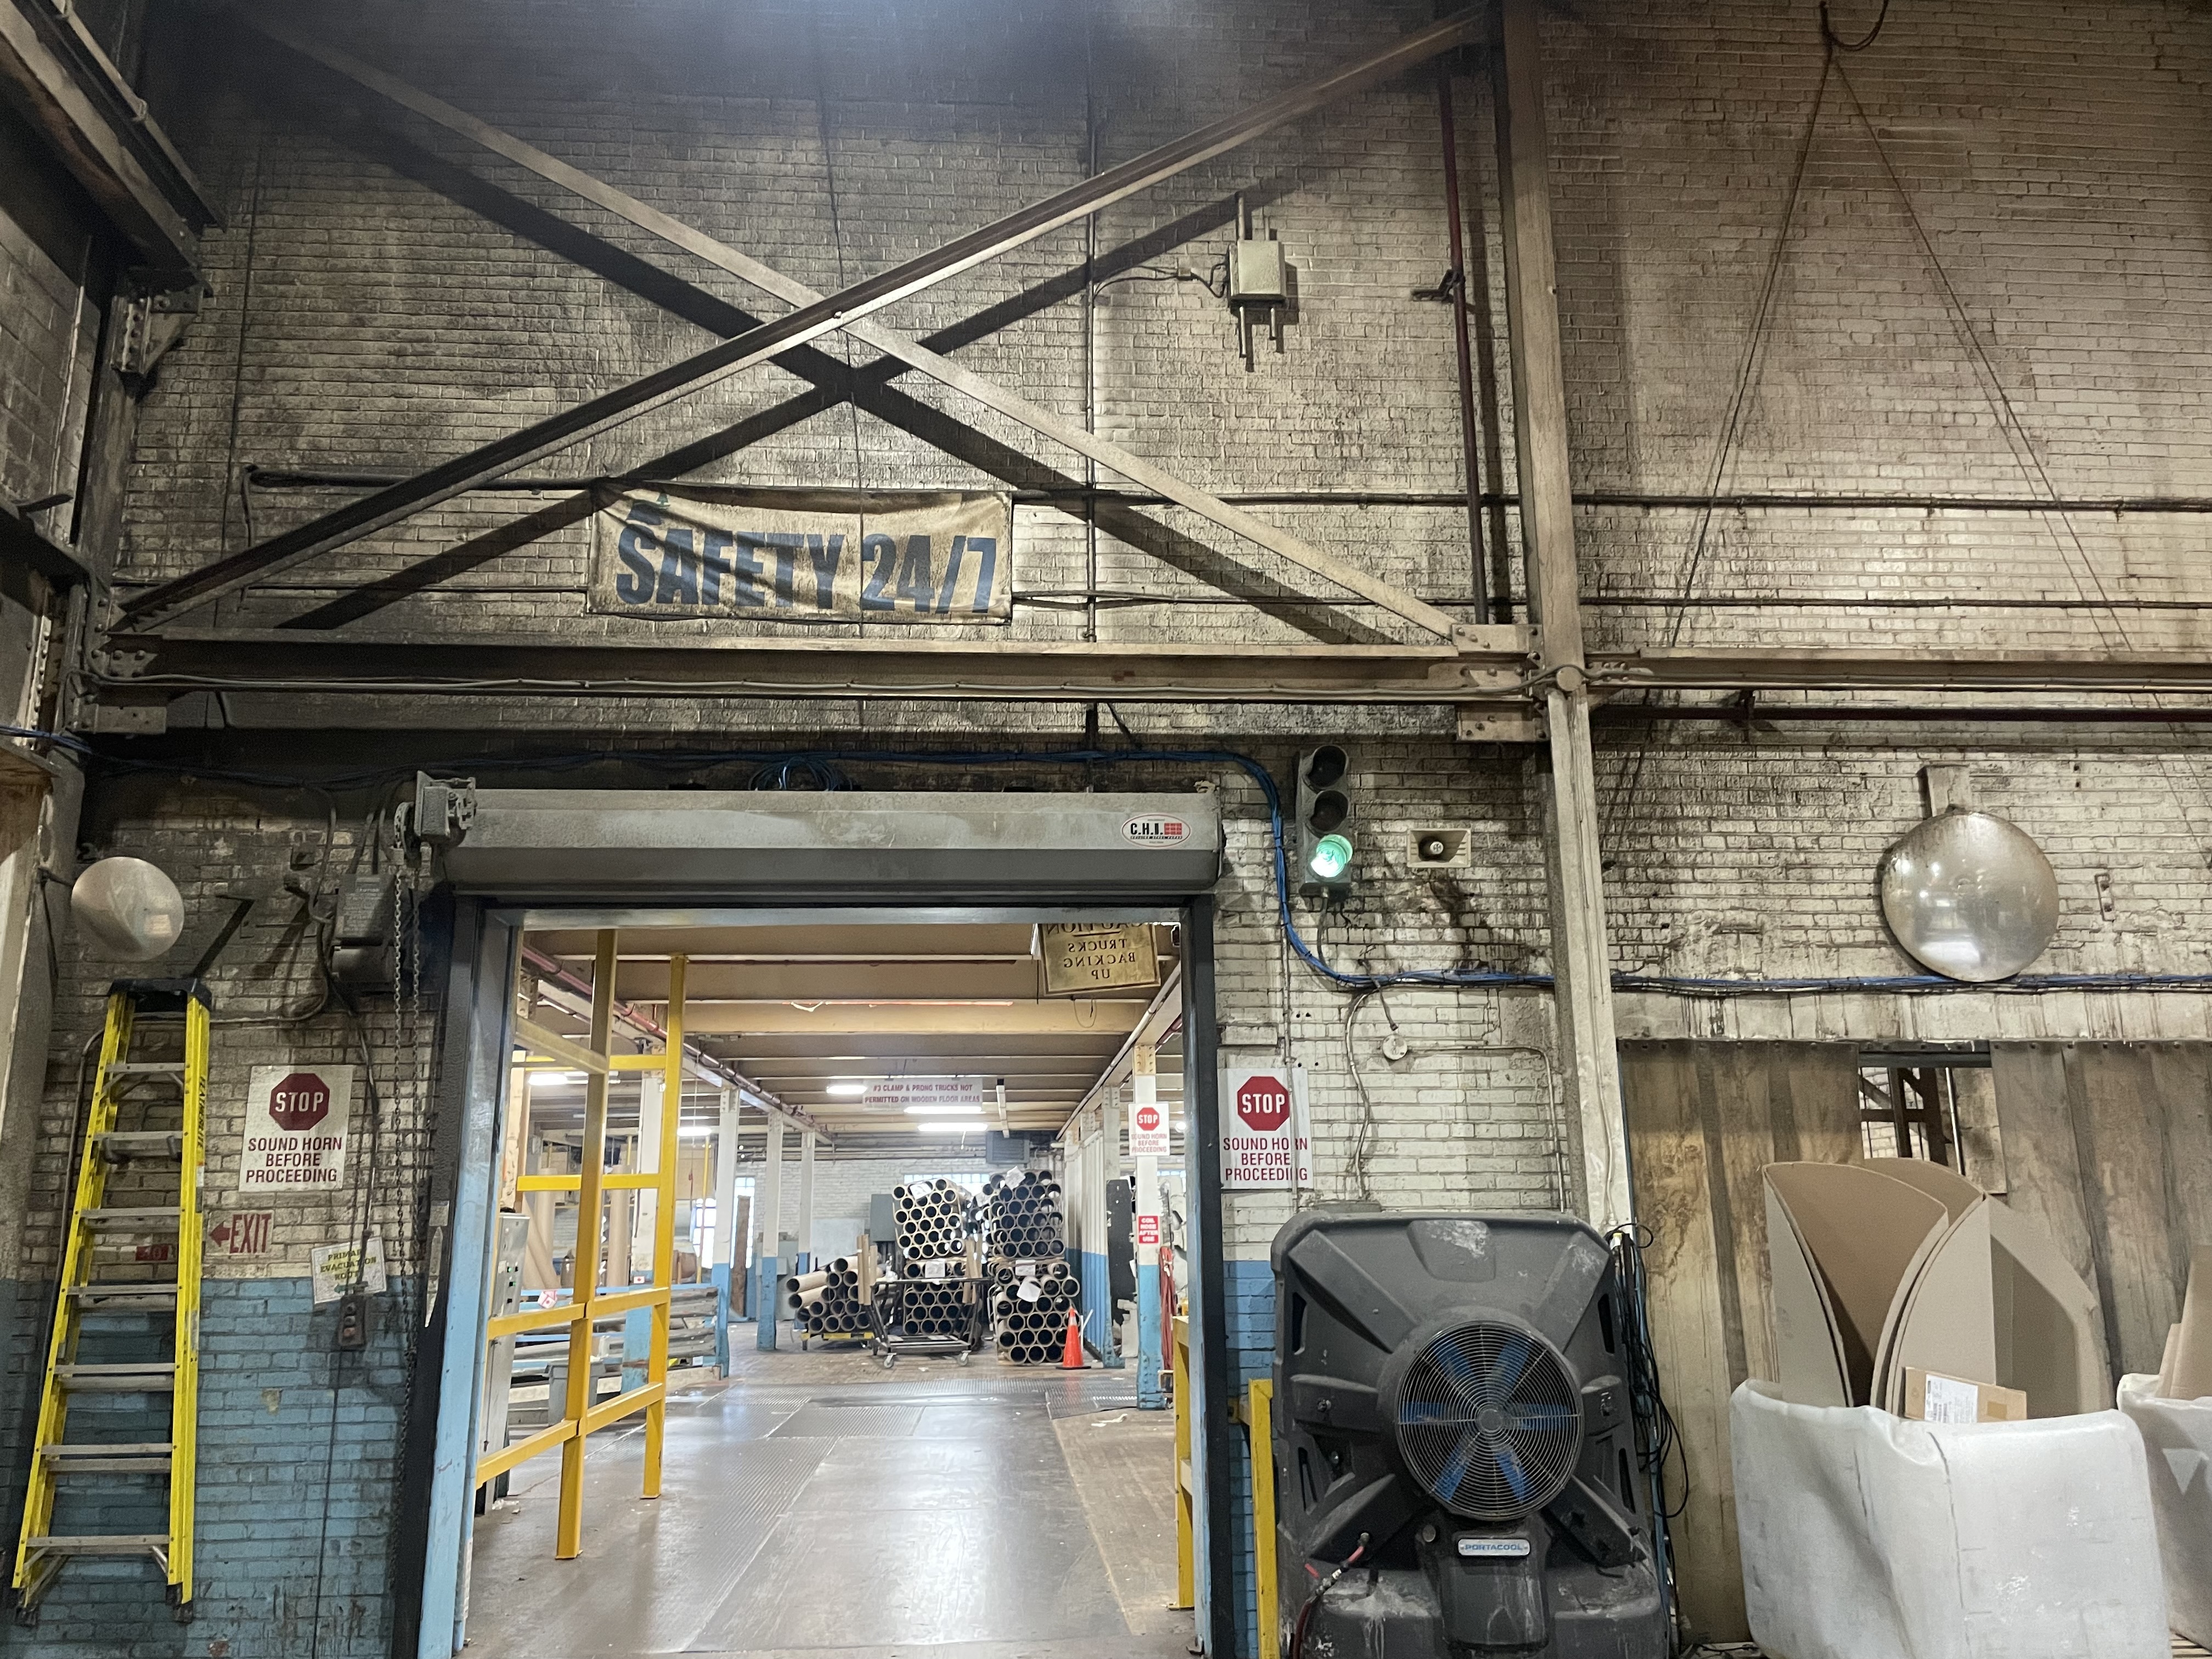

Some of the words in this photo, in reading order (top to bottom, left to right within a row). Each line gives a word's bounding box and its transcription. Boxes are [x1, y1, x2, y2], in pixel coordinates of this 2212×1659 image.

[616, 523, 846, 610] SAFETY
[861, 534, 997, 614] 24/7
[275, 1092, 324, 1113] STOP
[1242, 1093, 1285, 1114] STOP
[1138, 1114, 1158, 1124] STOP
[248, 1137, 298, 1151] SOUND
[302, 1137, 342, 1151] HORN
[1223, 1137, 1268, 1150] SOUND
[266, 1153, 321, 1167] BEFORE
[1241, 1153, 1291, 1166] BEFORE
[246, 1168, 337, 1183] PROCEEDING
[229, 1214, 272, 1255] EXIT
[328, 1249, 361, 1261] PRIMAR
[320, 1256, 376, 1273] EVACUATON
[334, 1270, 359, 1280] ROUT
